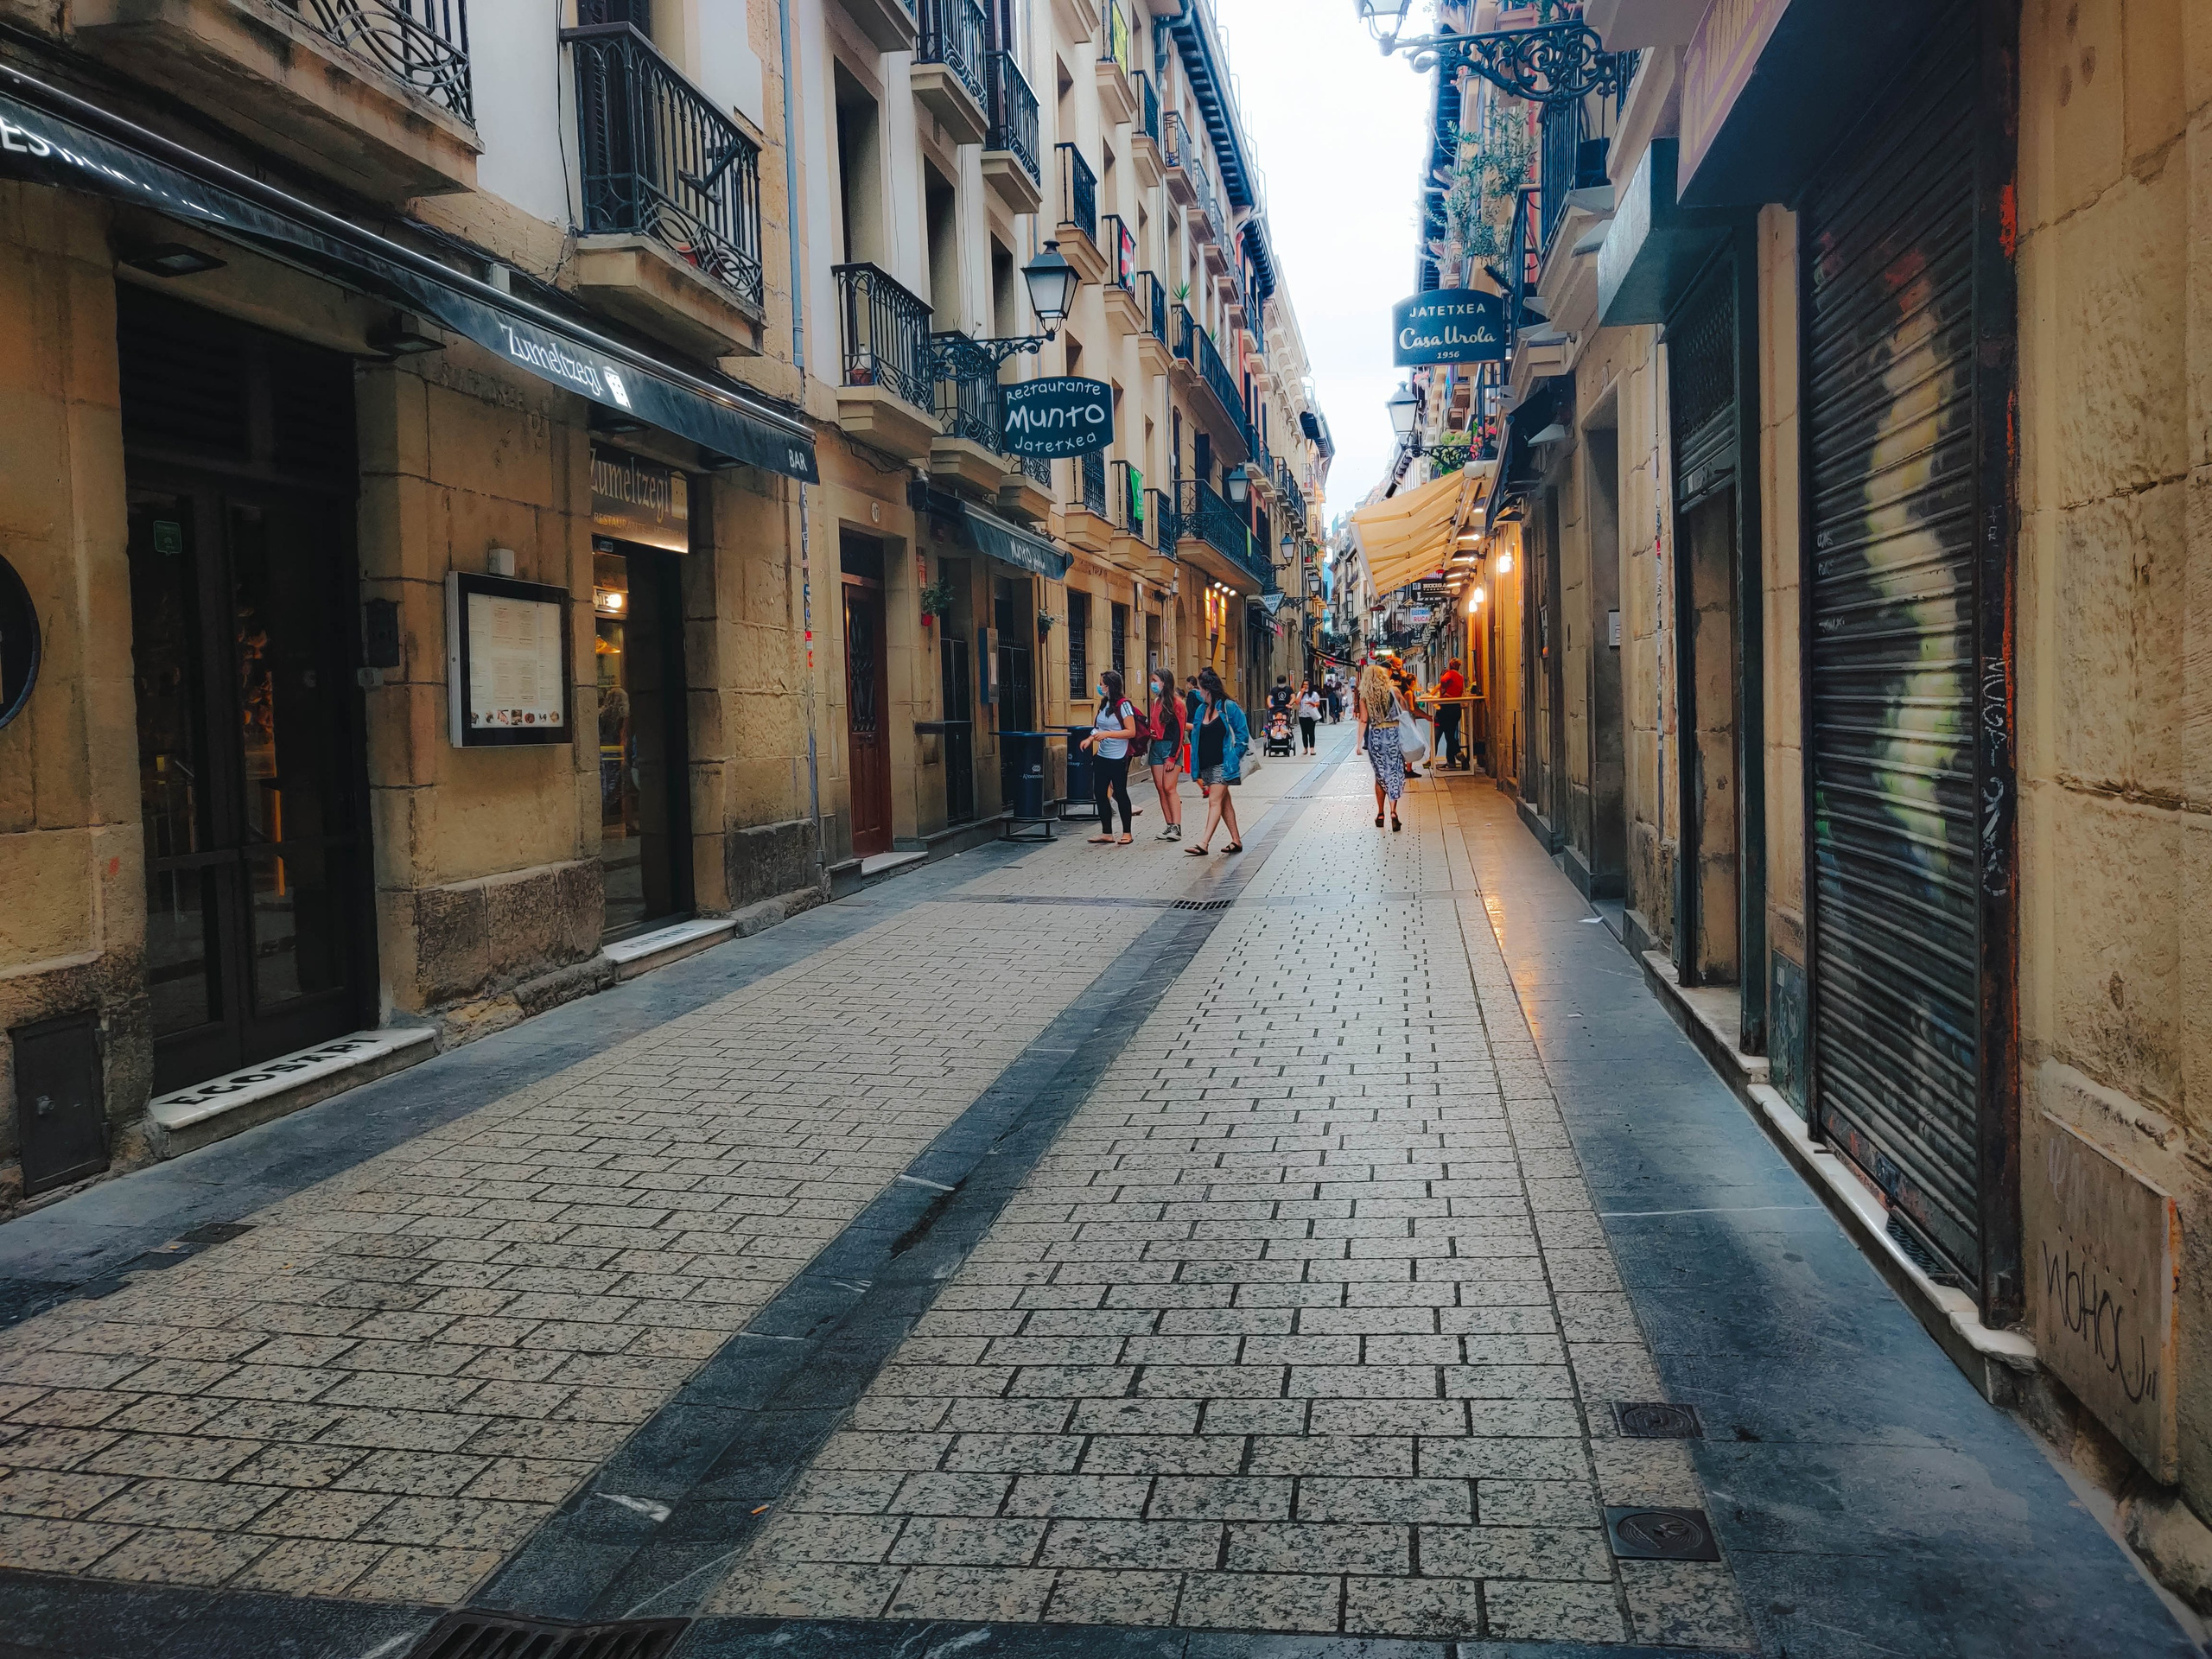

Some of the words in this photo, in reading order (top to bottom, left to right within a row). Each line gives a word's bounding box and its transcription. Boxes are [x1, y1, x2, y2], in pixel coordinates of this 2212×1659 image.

[1409, 303, 1485, 318] JATETXEA
[1399, 327, 1443, 350] Casa
[1444, 325, 1497, 345] Urola
[498, 321, 605, 397] Zumeltzegi
[1436, 351, 1460, 359] 1956
[1006, 380, 1101, 405] Restaurante
[788, 448, 808, 472] BAR
[589, 447, 671, 524] Zumeltzegi
